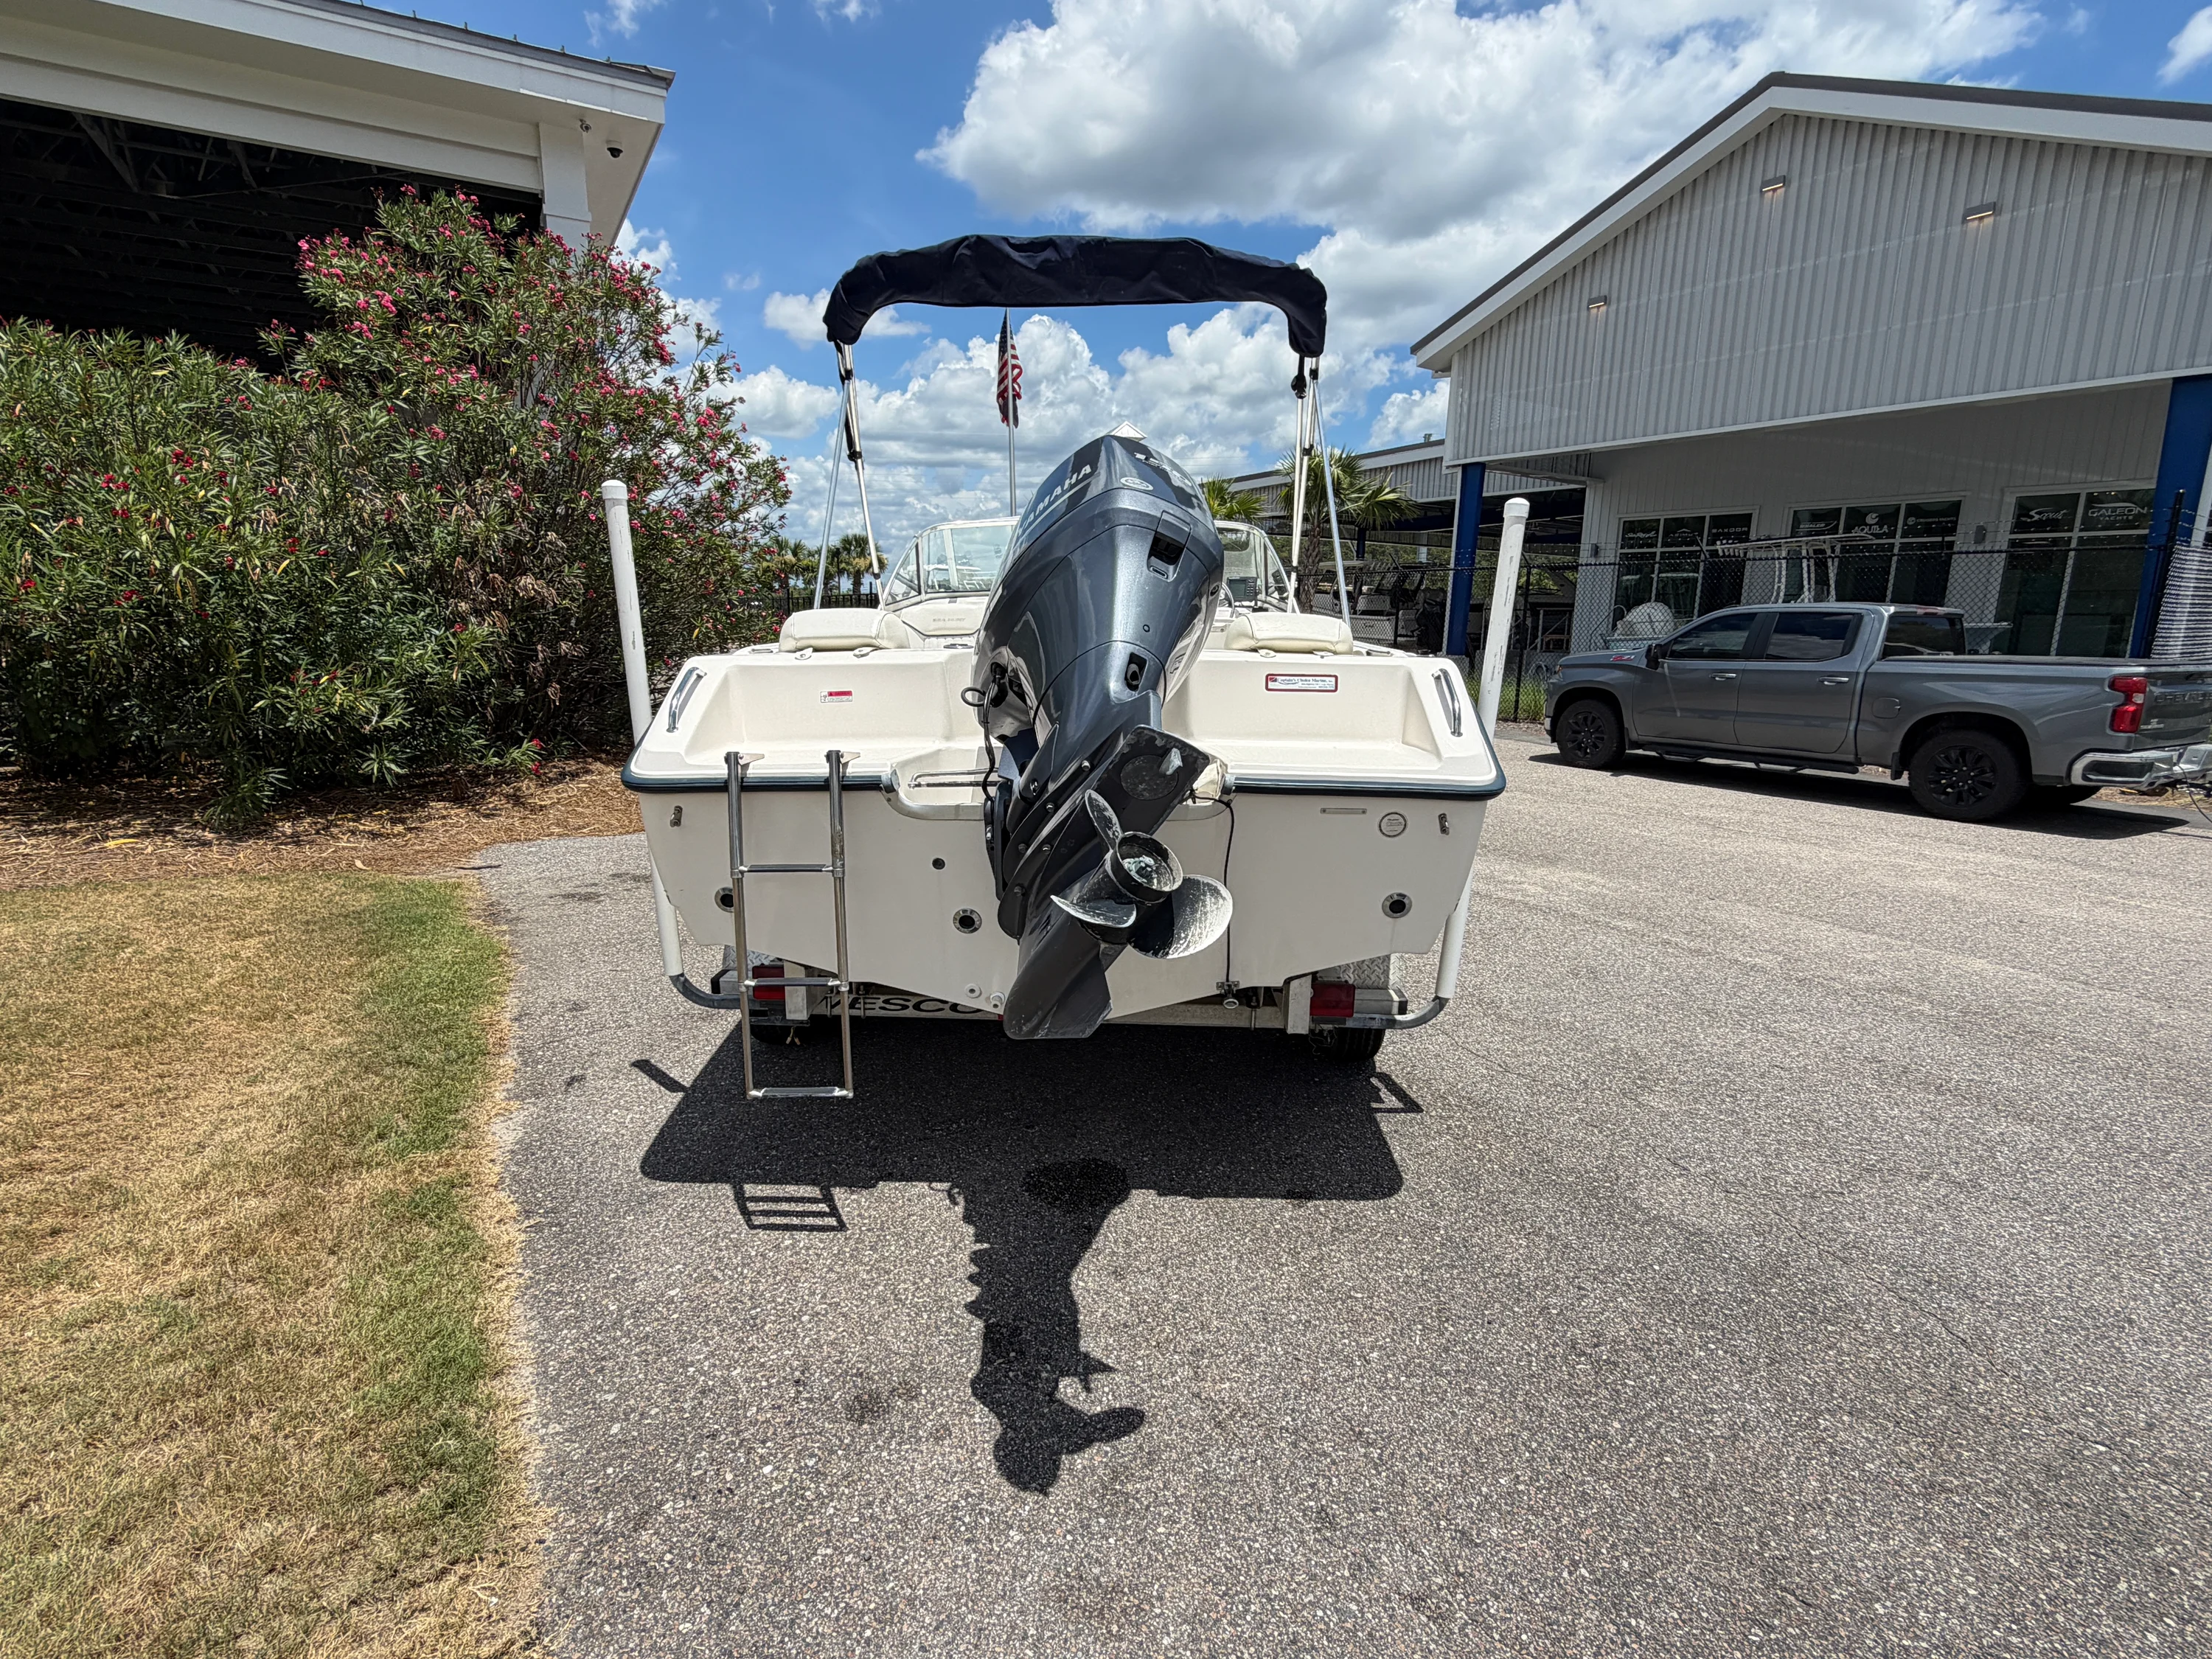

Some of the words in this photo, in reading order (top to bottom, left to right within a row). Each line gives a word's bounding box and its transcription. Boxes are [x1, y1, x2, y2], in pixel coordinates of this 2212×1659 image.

[1018, 465, 1092, 537] YAMAHA
[2020, 507, 2070, 522] Scout
[2087, 507, 2148, 517] GALEON
[1852, 524, 1889, 534] AQUILA
